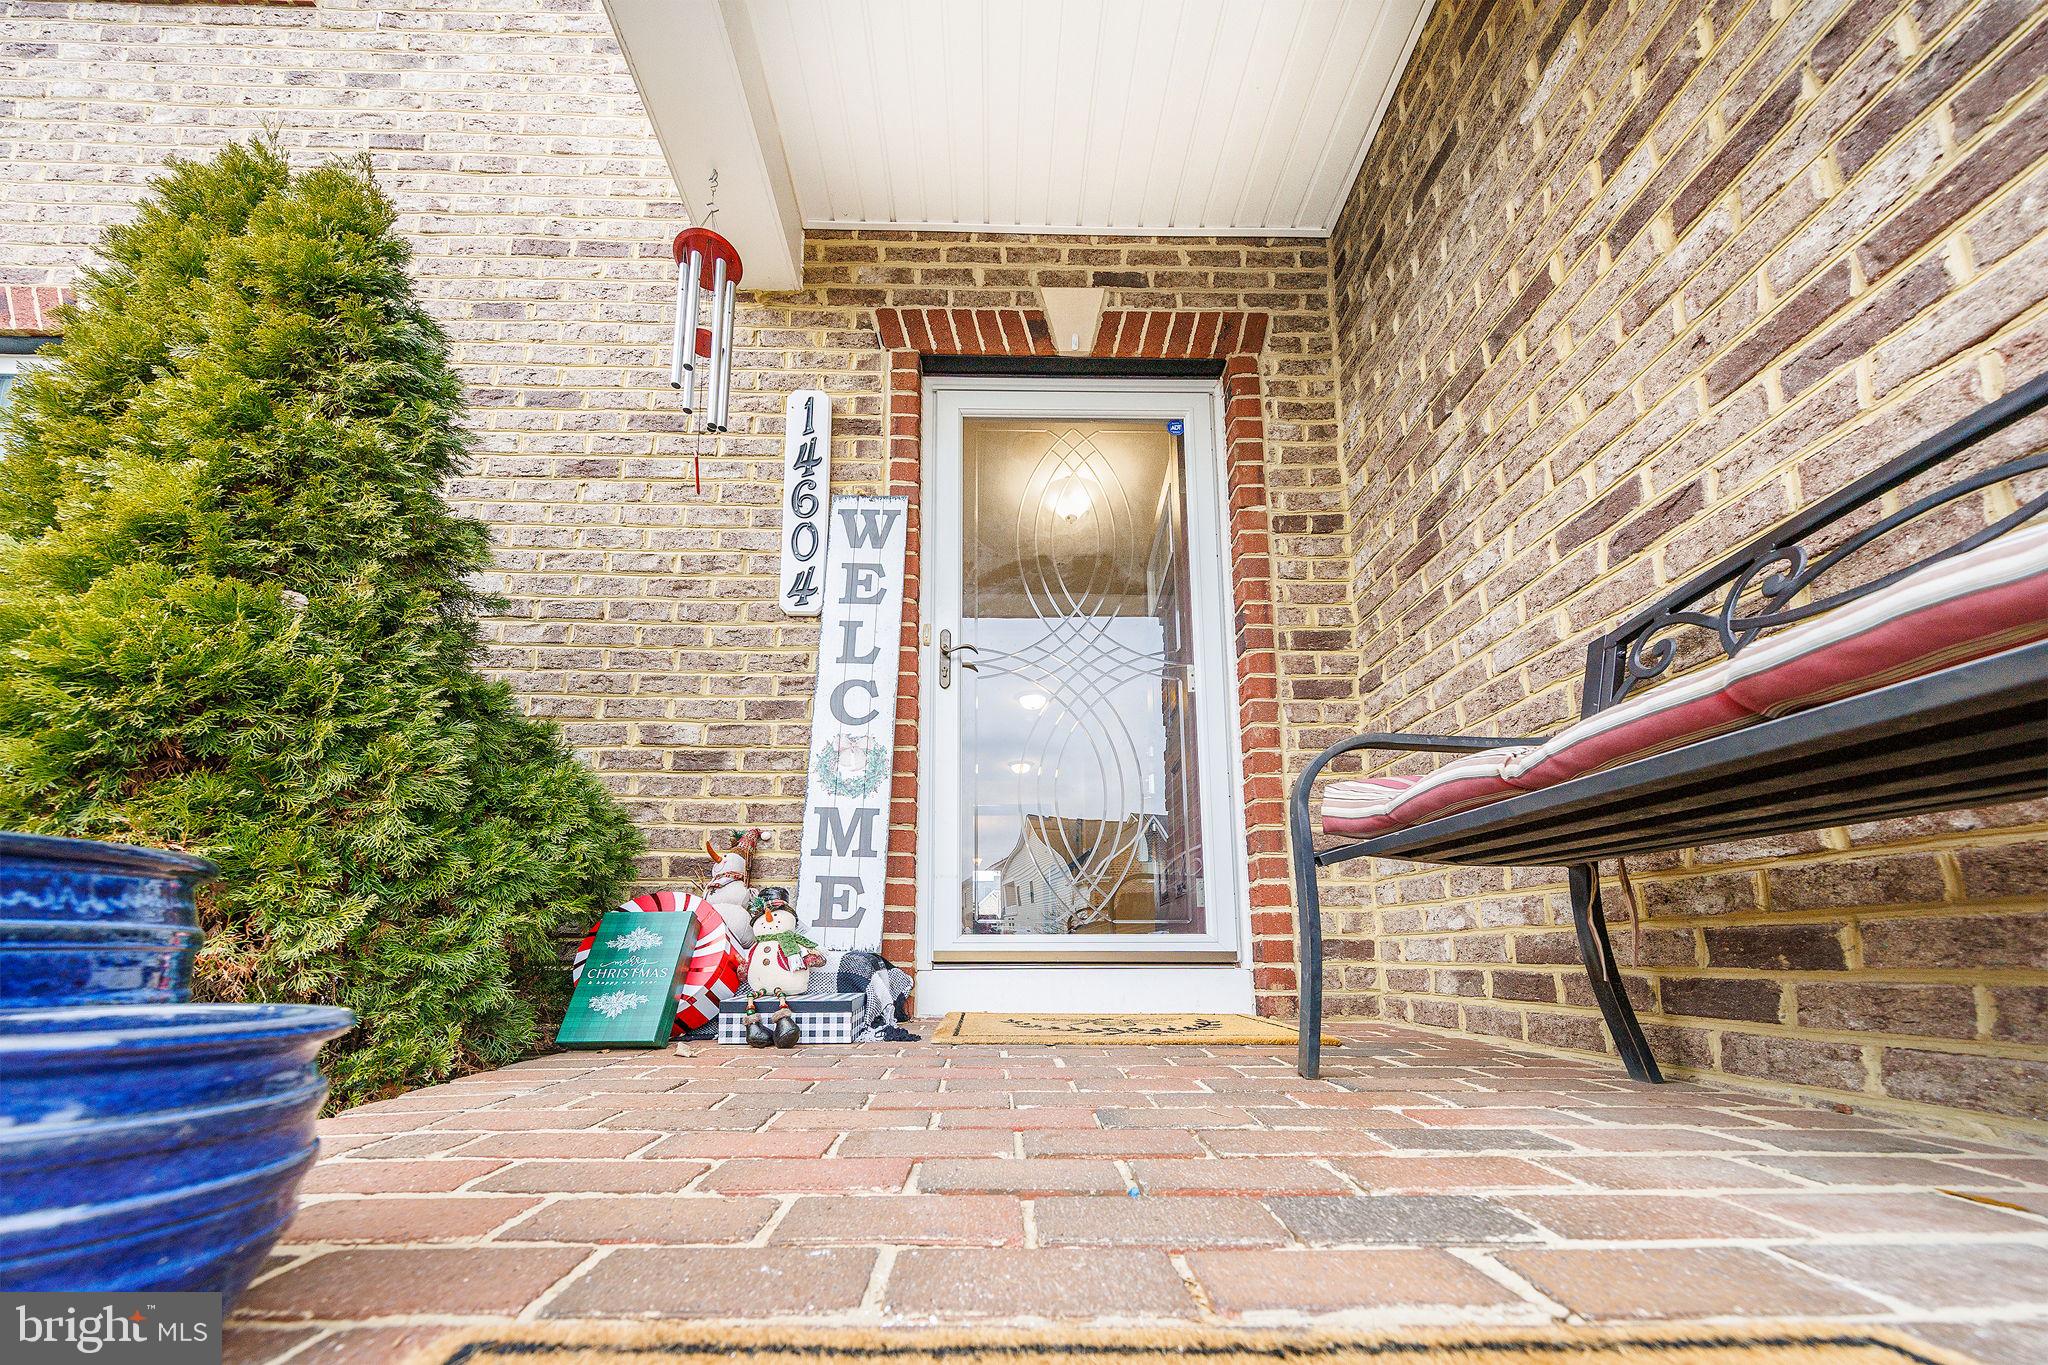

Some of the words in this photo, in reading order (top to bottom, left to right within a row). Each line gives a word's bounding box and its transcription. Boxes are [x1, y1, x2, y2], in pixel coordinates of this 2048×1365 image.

[787, 396, 823, 606] 14604
[587, 967, 669, 979] CHRISTMAS
[600, 955, 658, 974] merry
